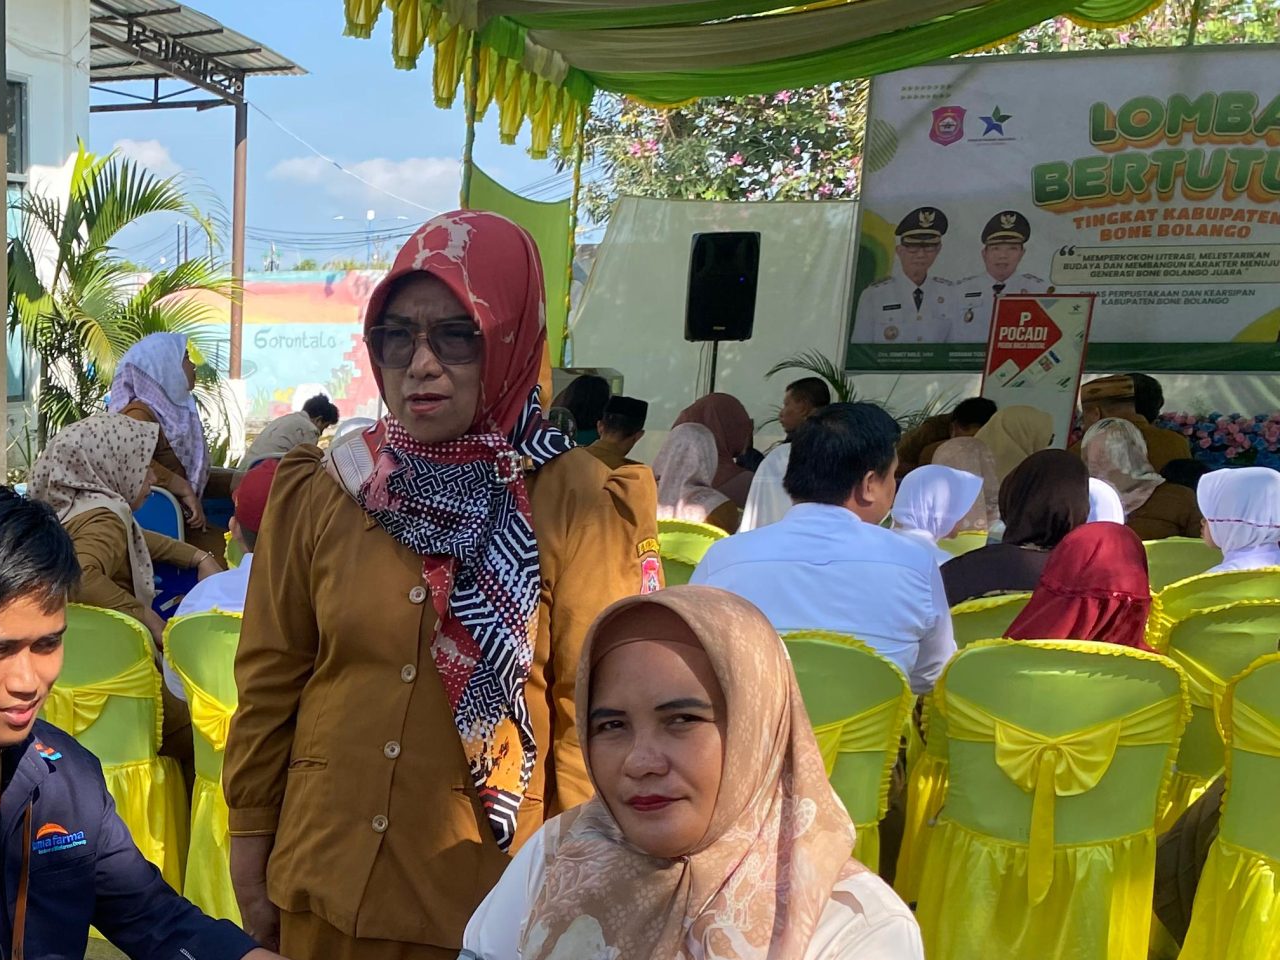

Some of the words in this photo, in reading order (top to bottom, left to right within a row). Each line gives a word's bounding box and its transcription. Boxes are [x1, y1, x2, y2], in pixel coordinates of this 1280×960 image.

[1089, 91, 1280, 148] LOMBA
[1073, 208, 1158, 229] TINGKAT
[1163, 207, 1280, 224] KABUPATEN
[1100, 225, 1152, 241] BONE
[1157, 224, 1251, 239] BOLANGO
[1199, 251, 1270, 260] MELESTARIKAN
[1063, 262, 1101, 270] BUDAYA
[1102, 262, 1122, 270] DAN
[1122, 261, 1186, 269] MEMBANGUN
[1188, 260, 1238, 268] KARAKTER
[1239, 260, 1280, 268] MENUJU
[1090, 270, 1134, 278] GENERASI
[1136, 269, 1161, 277] BONE
[1163, 269, 1209, 277] BOLANGO
[1210, 268, 1242, 276] JUARA
[1108, 290, 1180, 298] PERPUSTAKAAN
[1181, 289, 1202, 297] DAN
[1203, 289, 1256, 297] KEARSIPAN
[1101, 298, 1154, 306] KABUPATEN
[1155, 297, 1181, 305] BONE
[1183, 297, 1229, 305] BOLANGO
[254, 327, 337, 349] Gorontalo
[999, 327, 1048, 341] POCADI
[53, 830, 85, 846] farma
